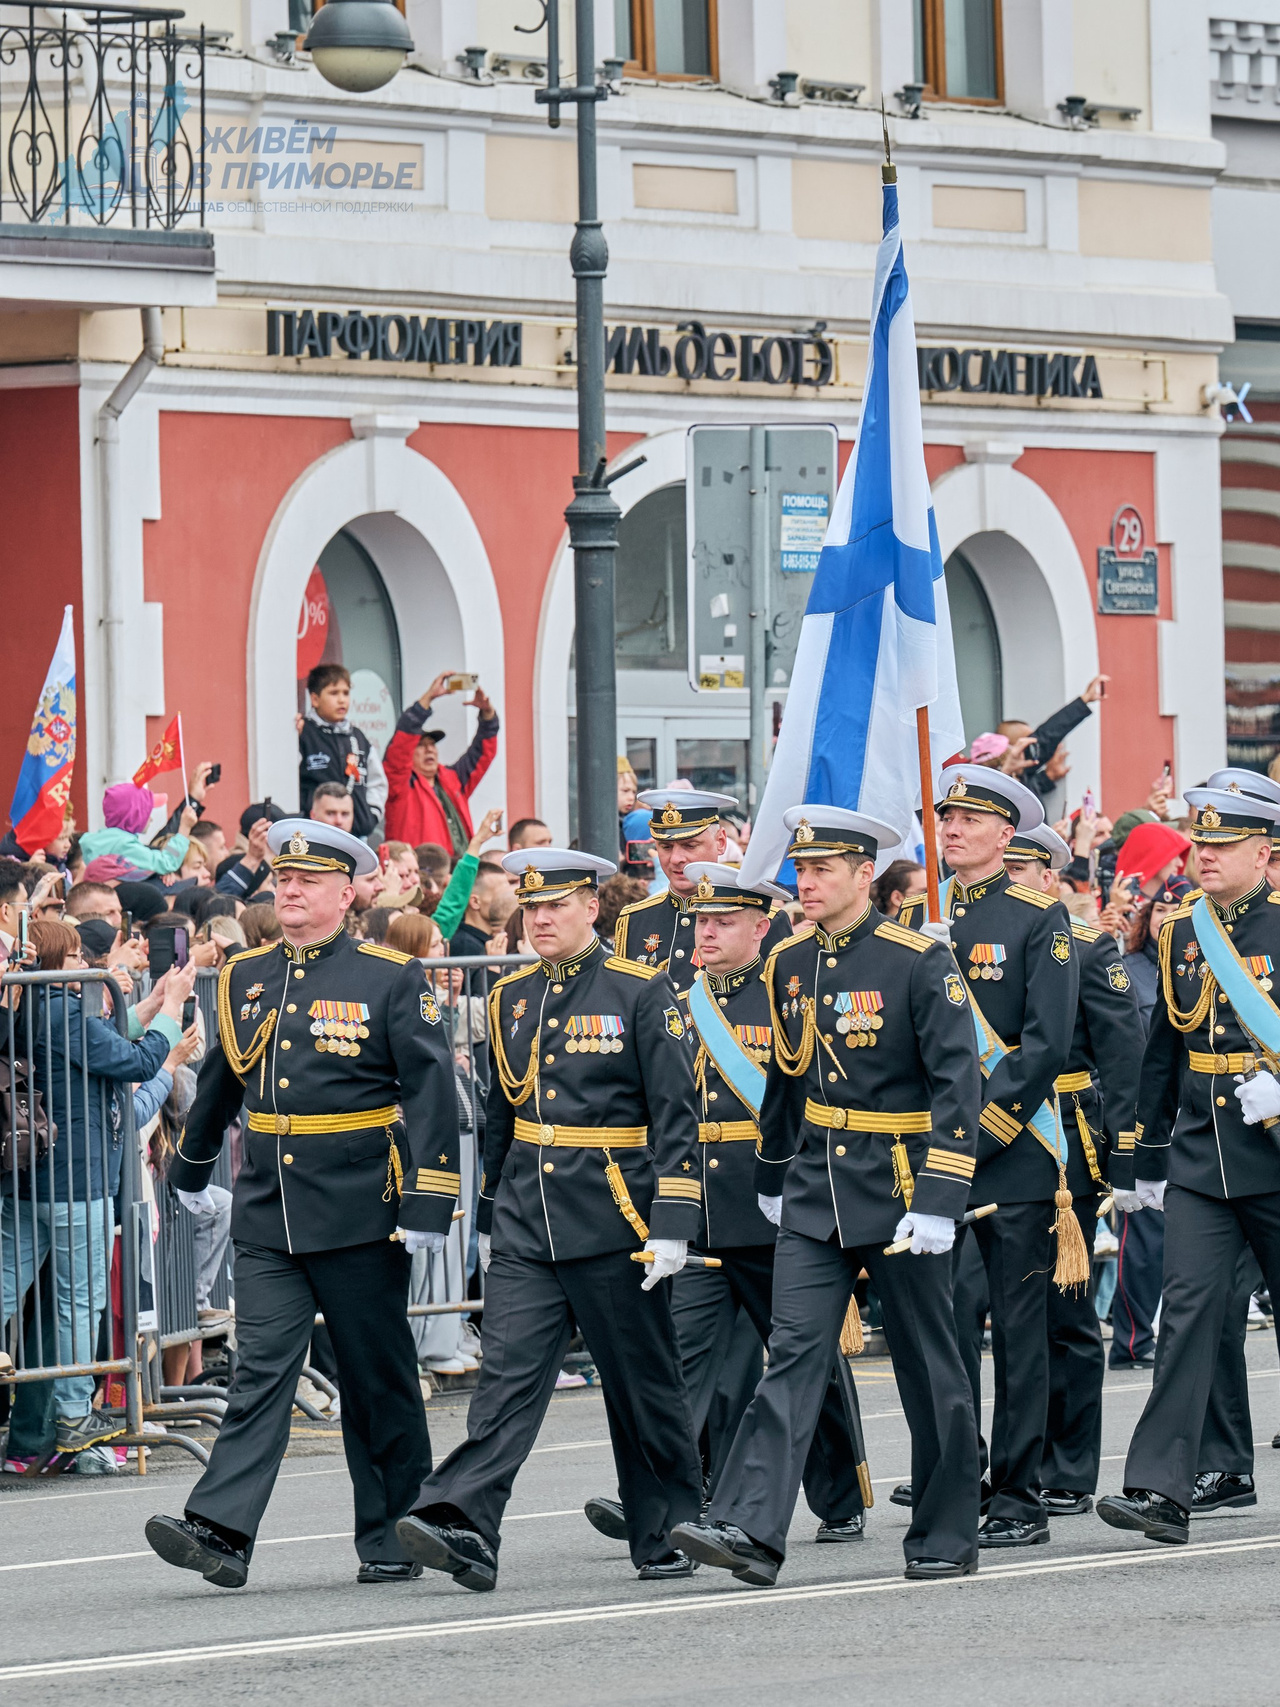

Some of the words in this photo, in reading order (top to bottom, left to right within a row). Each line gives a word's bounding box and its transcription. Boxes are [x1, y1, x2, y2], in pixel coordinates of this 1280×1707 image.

[266, 309, 522, 367] ПАРФЮМЕРИЯ
[916, 347, 1103, 399] КОСМЕТИКА
[782, 494, 828, 509] ПОМОЩЬ
[1118, 517, 1141, 552] 29
